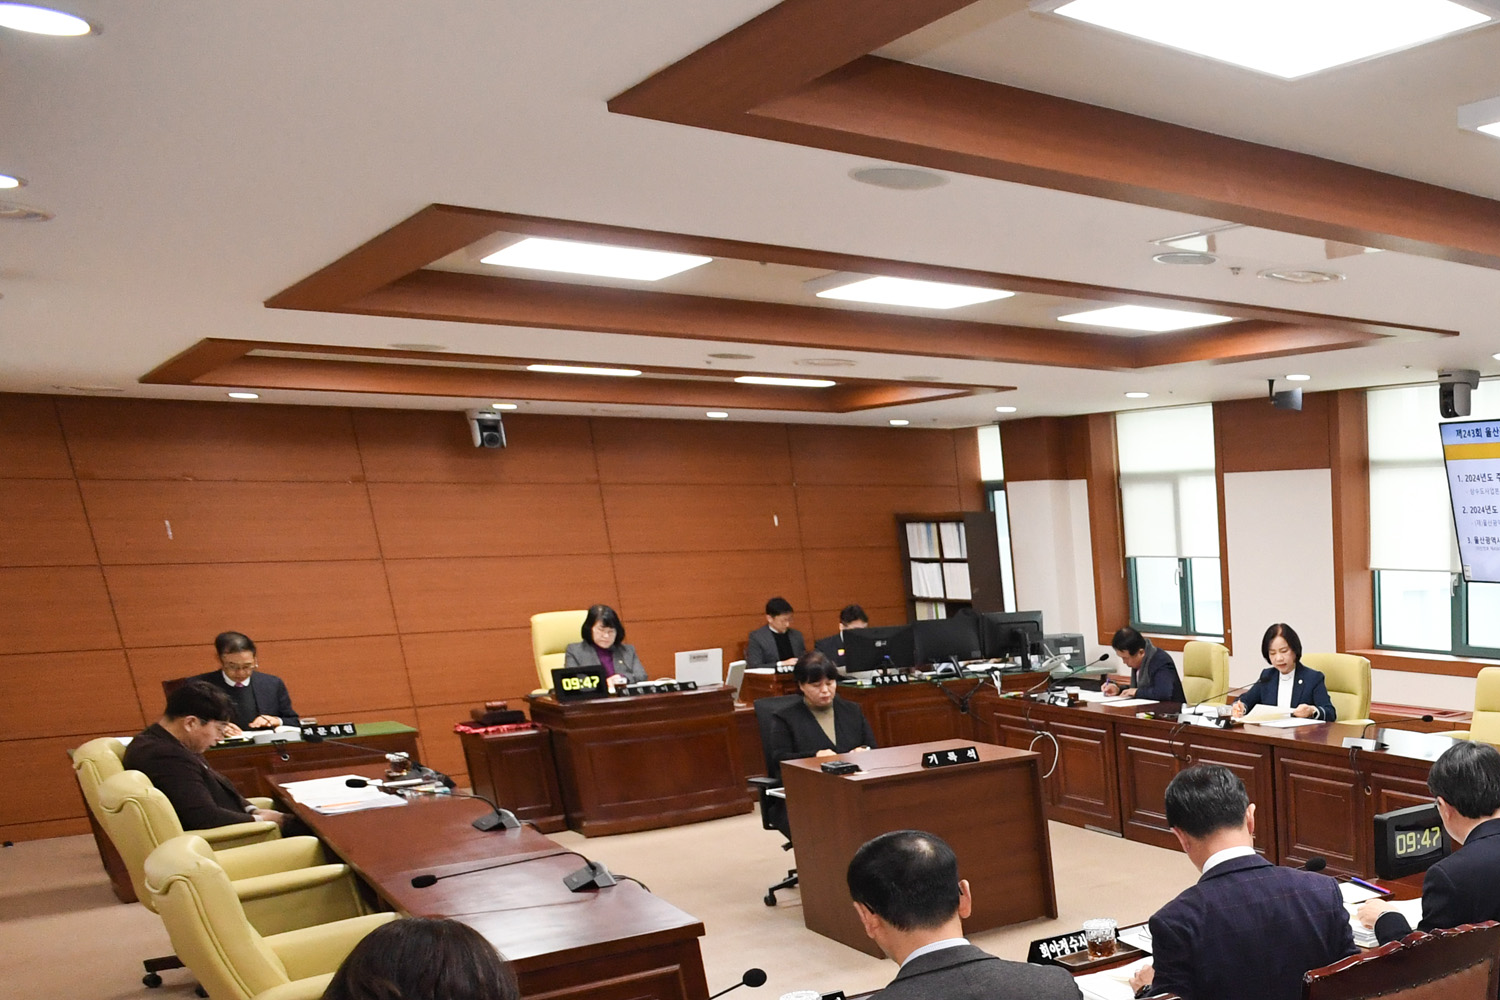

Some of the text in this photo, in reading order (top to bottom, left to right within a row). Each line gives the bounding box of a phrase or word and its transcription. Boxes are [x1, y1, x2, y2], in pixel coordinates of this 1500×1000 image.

[1455, 427, 1483, 440] 제243회
[1465, 472, 1494, 483] 2024년도
[1462, 505, 1469, 515] 2.
[1469, 504, 1498, 515] 2024년도
[1467, 535, 1473, 545] 3.
[561, 675, 600, 691] 09:47
[1396, 826, 1441, 855] 09:47
